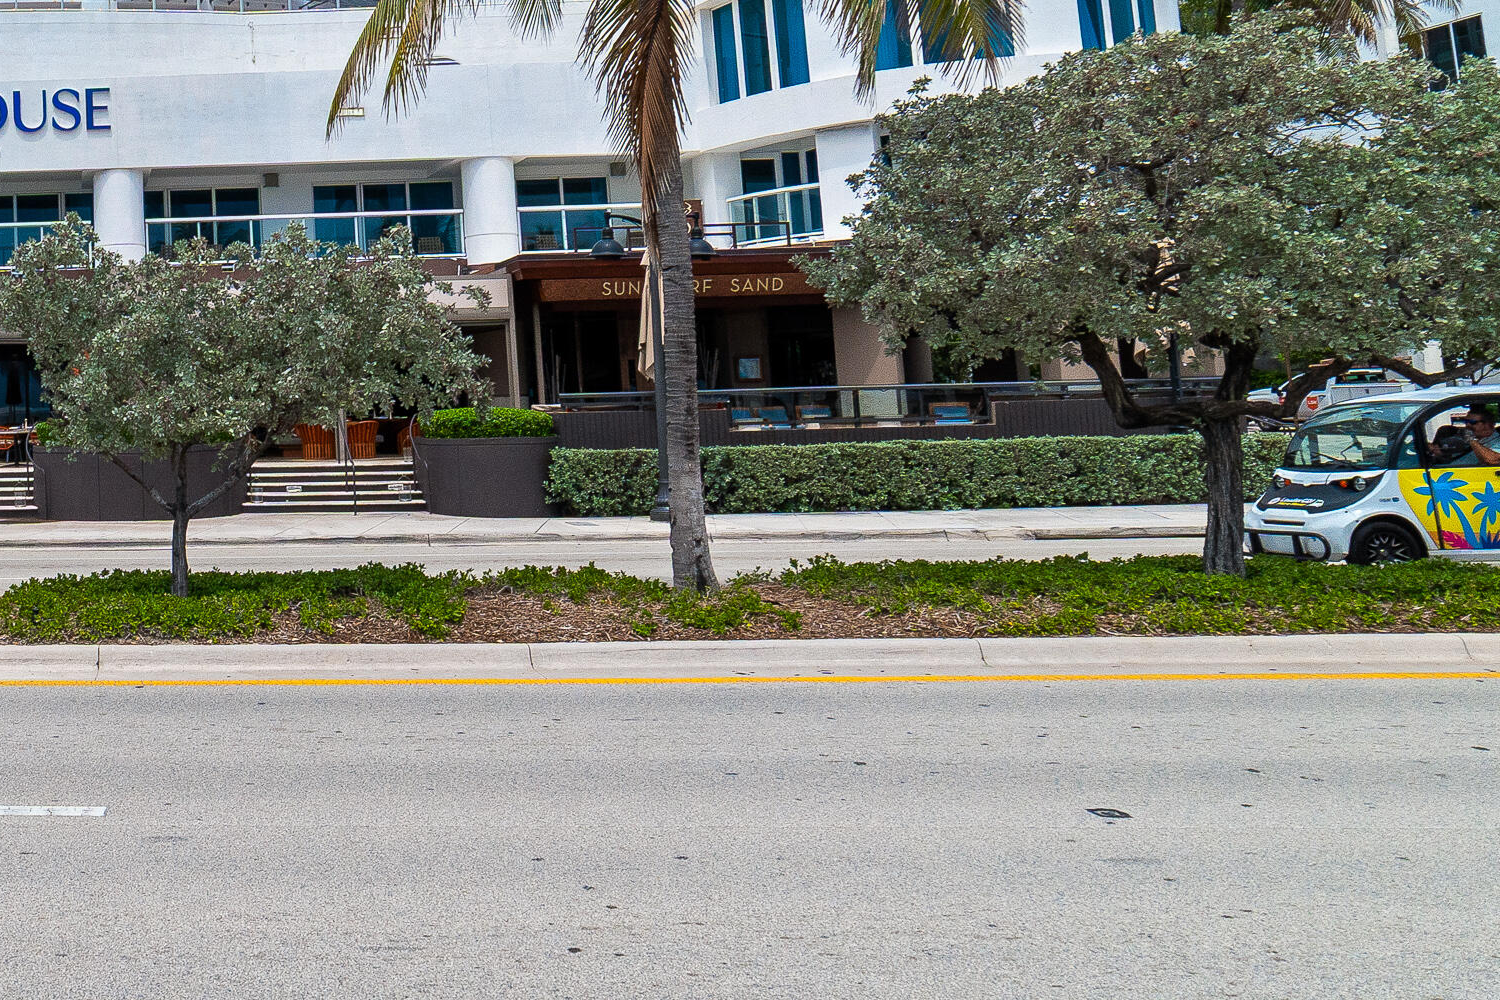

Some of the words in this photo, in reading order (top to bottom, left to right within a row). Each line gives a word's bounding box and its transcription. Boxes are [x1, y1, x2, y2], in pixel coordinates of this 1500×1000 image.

[601, 281, 640, 296] SUN
[692, 279, 713, 293] RF
[730, 277, 784, 293] SAND
